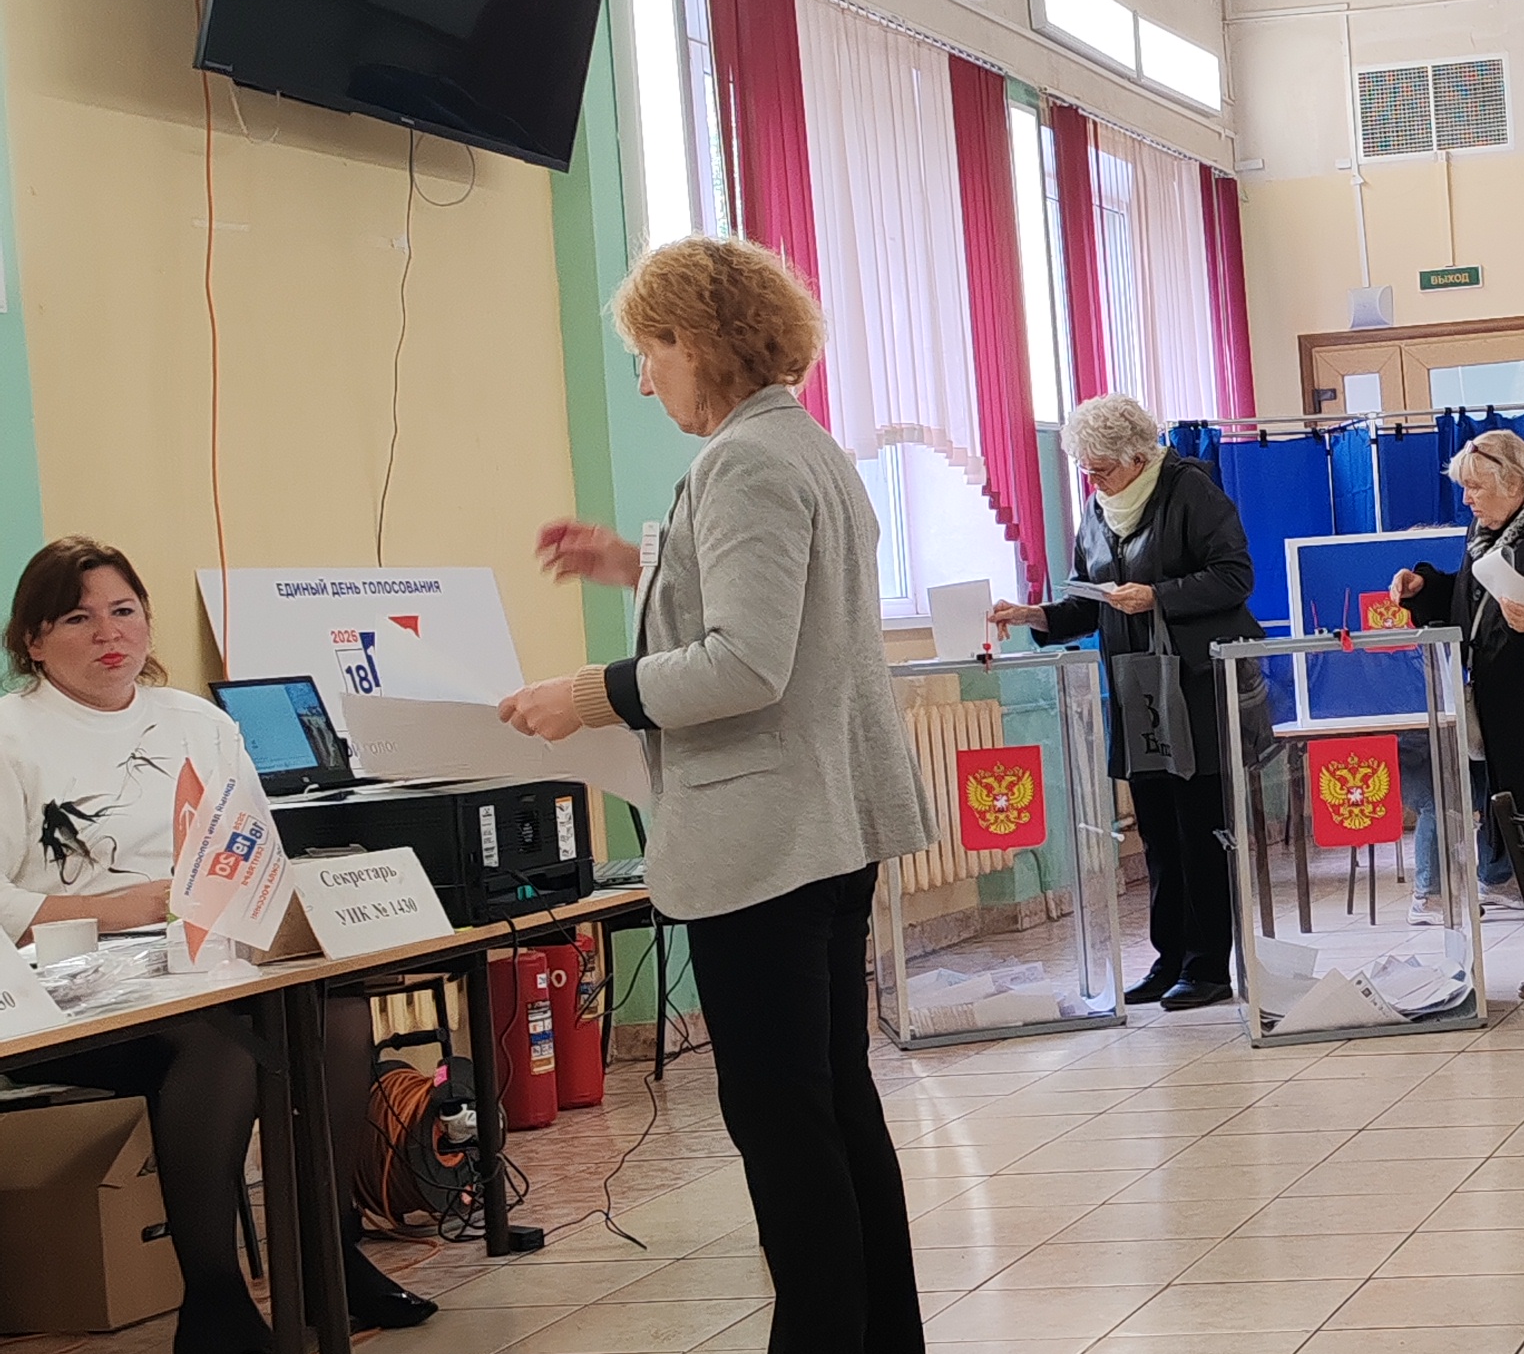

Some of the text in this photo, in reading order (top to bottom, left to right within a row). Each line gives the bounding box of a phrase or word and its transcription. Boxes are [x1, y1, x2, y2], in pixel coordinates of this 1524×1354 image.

[1430, 272, 1470, 285] ВЫХОД
[276, 579, 442, 598] ЕДИНЫЙ ДЕНЬ ГОЛОСОВАНИЯ
[345, 664, 374, 695] 18
[320, 865, 397, 887] Секретарь
[389, 897, 418, 916] 1430
